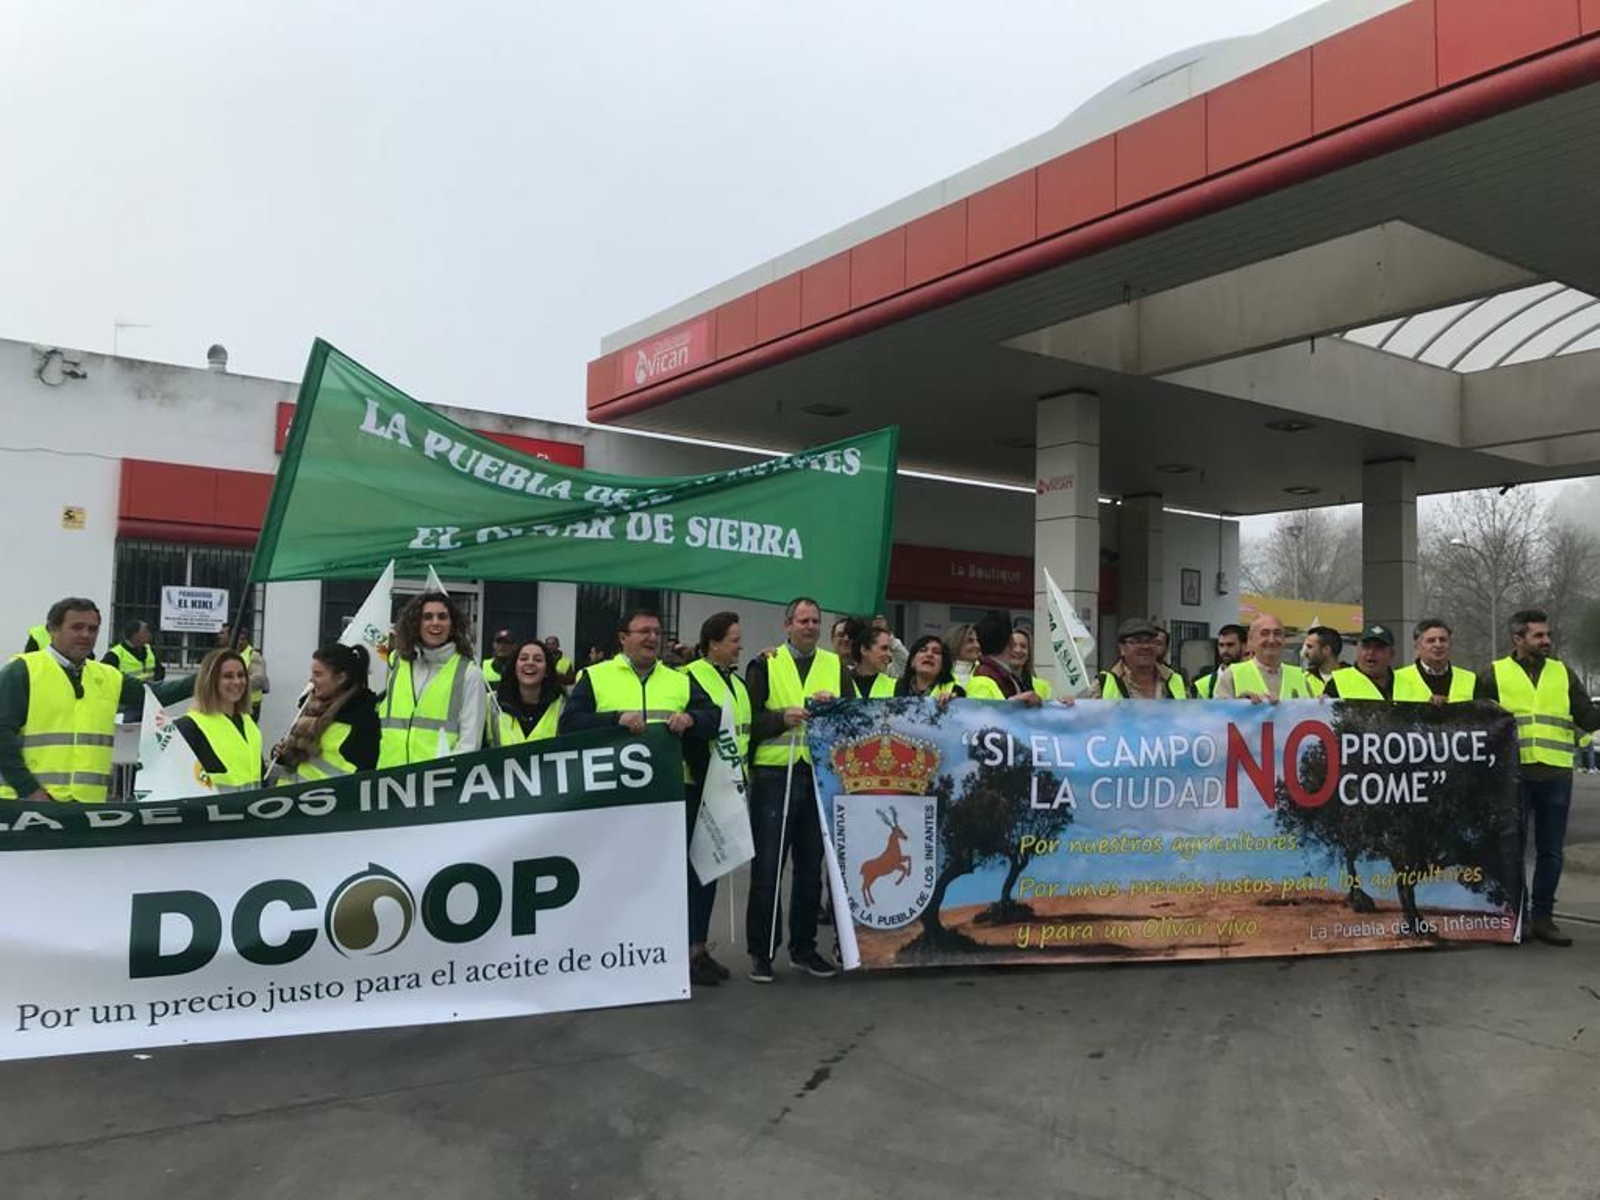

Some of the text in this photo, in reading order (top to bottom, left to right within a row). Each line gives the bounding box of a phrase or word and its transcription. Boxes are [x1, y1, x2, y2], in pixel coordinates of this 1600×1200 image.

[360, 398, 413, 448] LA
[424, 429, 574, 500] PUEBLA
[408, 526, 462, 550] EL
[627, 511, 675, 545] DE
[685, 515, 803, 560] SIERRA
[951, 562, 965, 576] La
[178, 599, 213, 610] EL KIKI
[718, 730, 741, 769] UPA
[1031, 735, 1076, 768] EL
[1086, 734, 1217, 768] CAMPO
[1225, 719, 1341, 810] NO
[1340, 730, 1498, 769] PRODUCE,
[0, 743, 654, 831] A DE LOS INFANTES
[1030, 776, 1078, 810] LA
[1090, 775, 1226, 811] CIUDAD
[925, 805, 934, 860] INFANTES
[1019, 834, 1061, 856] Por
[1069, 834, 1164, 855] nuestros
[925, 866, 934, 890] LOS
[1018, 863, 1484, 902] Por unos precios justos para los agricultores
[861, 910, 873, 923] LA
[877, 907, 917, 926] PUEBLA
[916, 892, 928, 907] DE
[1016, 924, 1031, 948] y
[1040, 923, 1094, 949] para
[1104, 924, 1133, 938] un
[1142, 915, 1211, 939] Olivar
[1310, 913, 1513, 940] La Puebla de los Infantes
[15, 943, 668, 1032] Por un precio justo para el aceite de oliva
